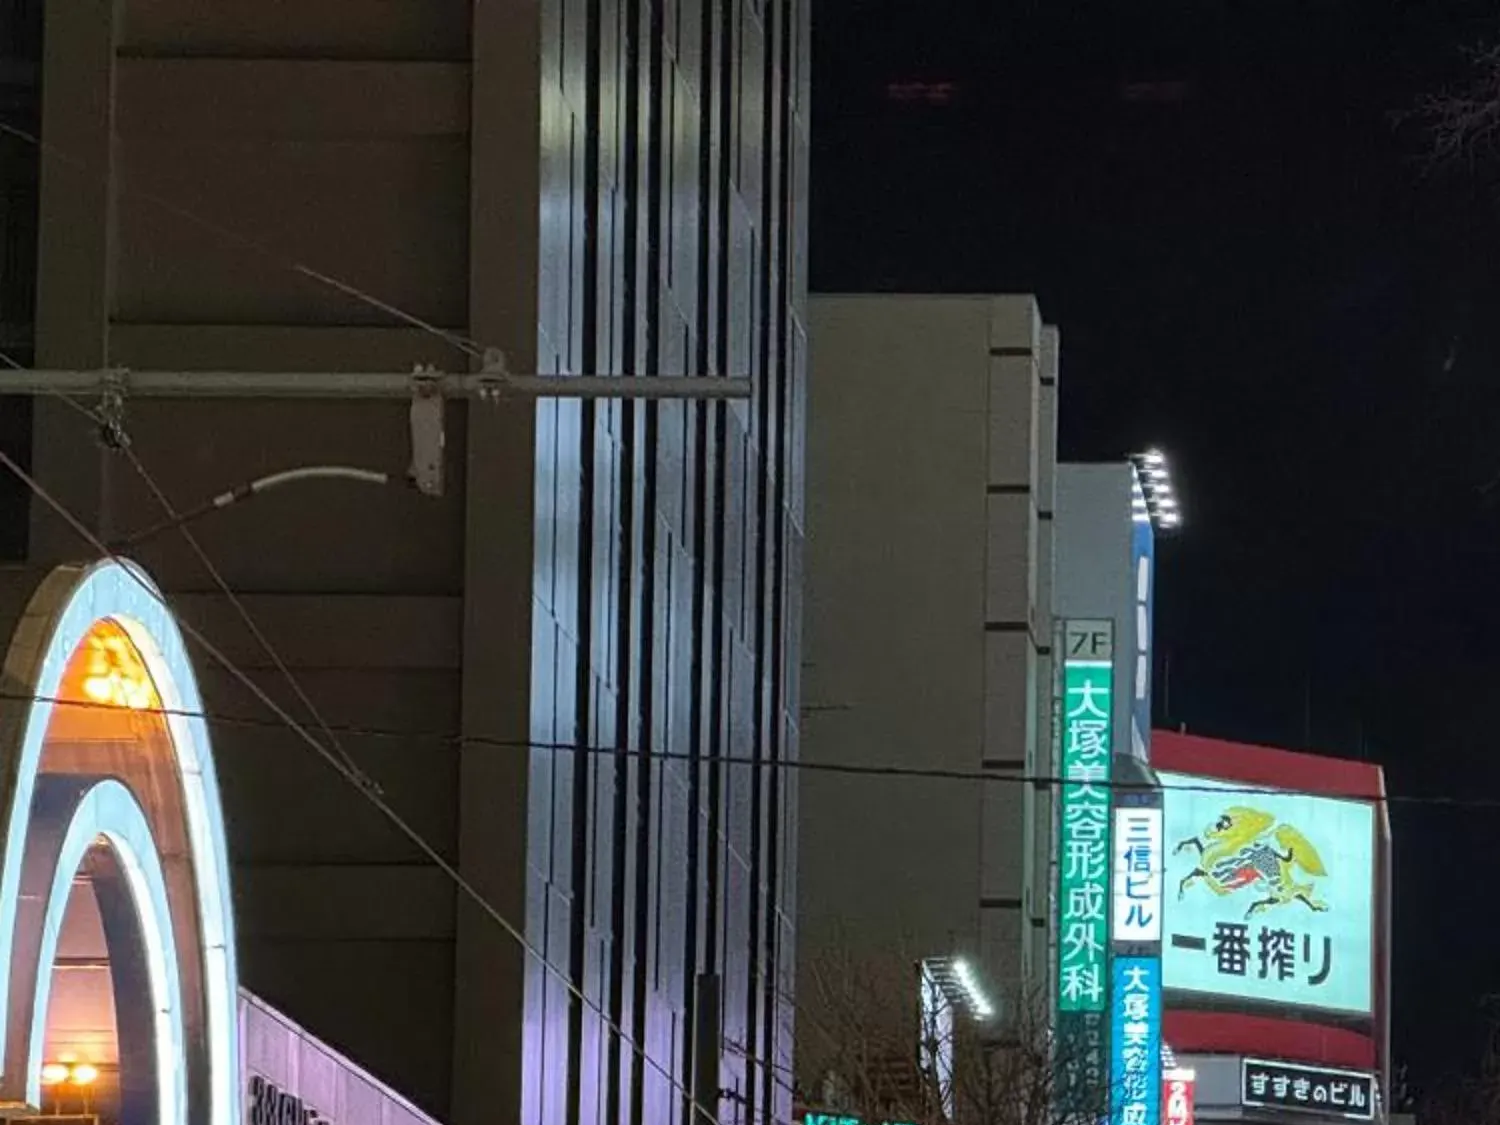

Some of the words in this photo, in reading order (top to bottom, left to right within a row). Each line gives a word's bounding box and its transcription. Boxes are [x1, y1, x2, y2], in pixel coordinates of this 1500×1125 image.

[1069, 631, 1108, 655] 7F
[1062, 679, 1110, 1002] 大塚美容形成外科
[1123, 817, 1154, 929] 三信ビル
[1171, 921, 1332, 986] 一番搾り
[1250, 1072, 1366, 1107] すすきのビル
